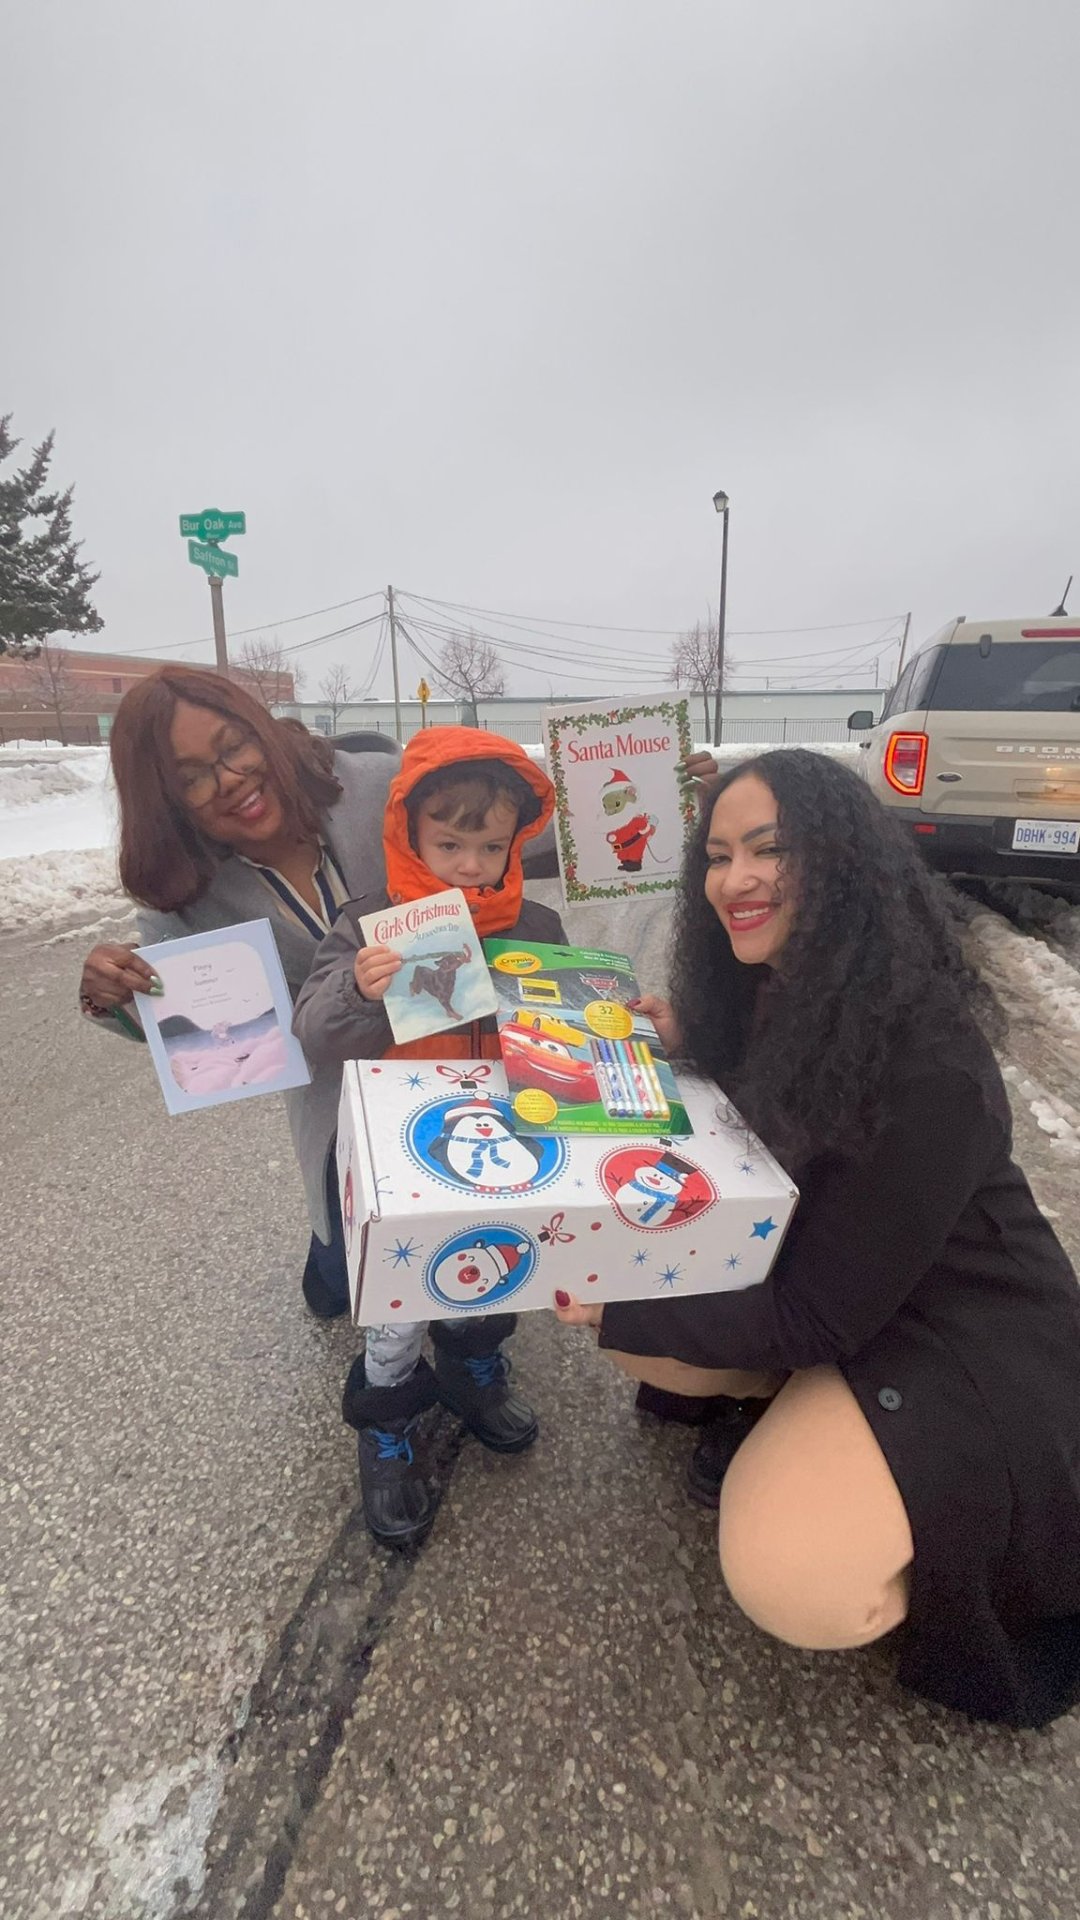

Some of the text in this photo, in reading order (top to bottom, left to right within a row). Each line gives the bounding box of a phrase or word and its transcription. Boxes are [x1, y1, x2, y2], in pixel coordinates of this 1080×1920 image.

[182, 518, 242, 531] Bur Oak Ave
[567, 733, 671, 764] Santa Mouse
[374, 903, 461, 944] Carl's Christmas
[599, 1005, 614, 1015] 32
